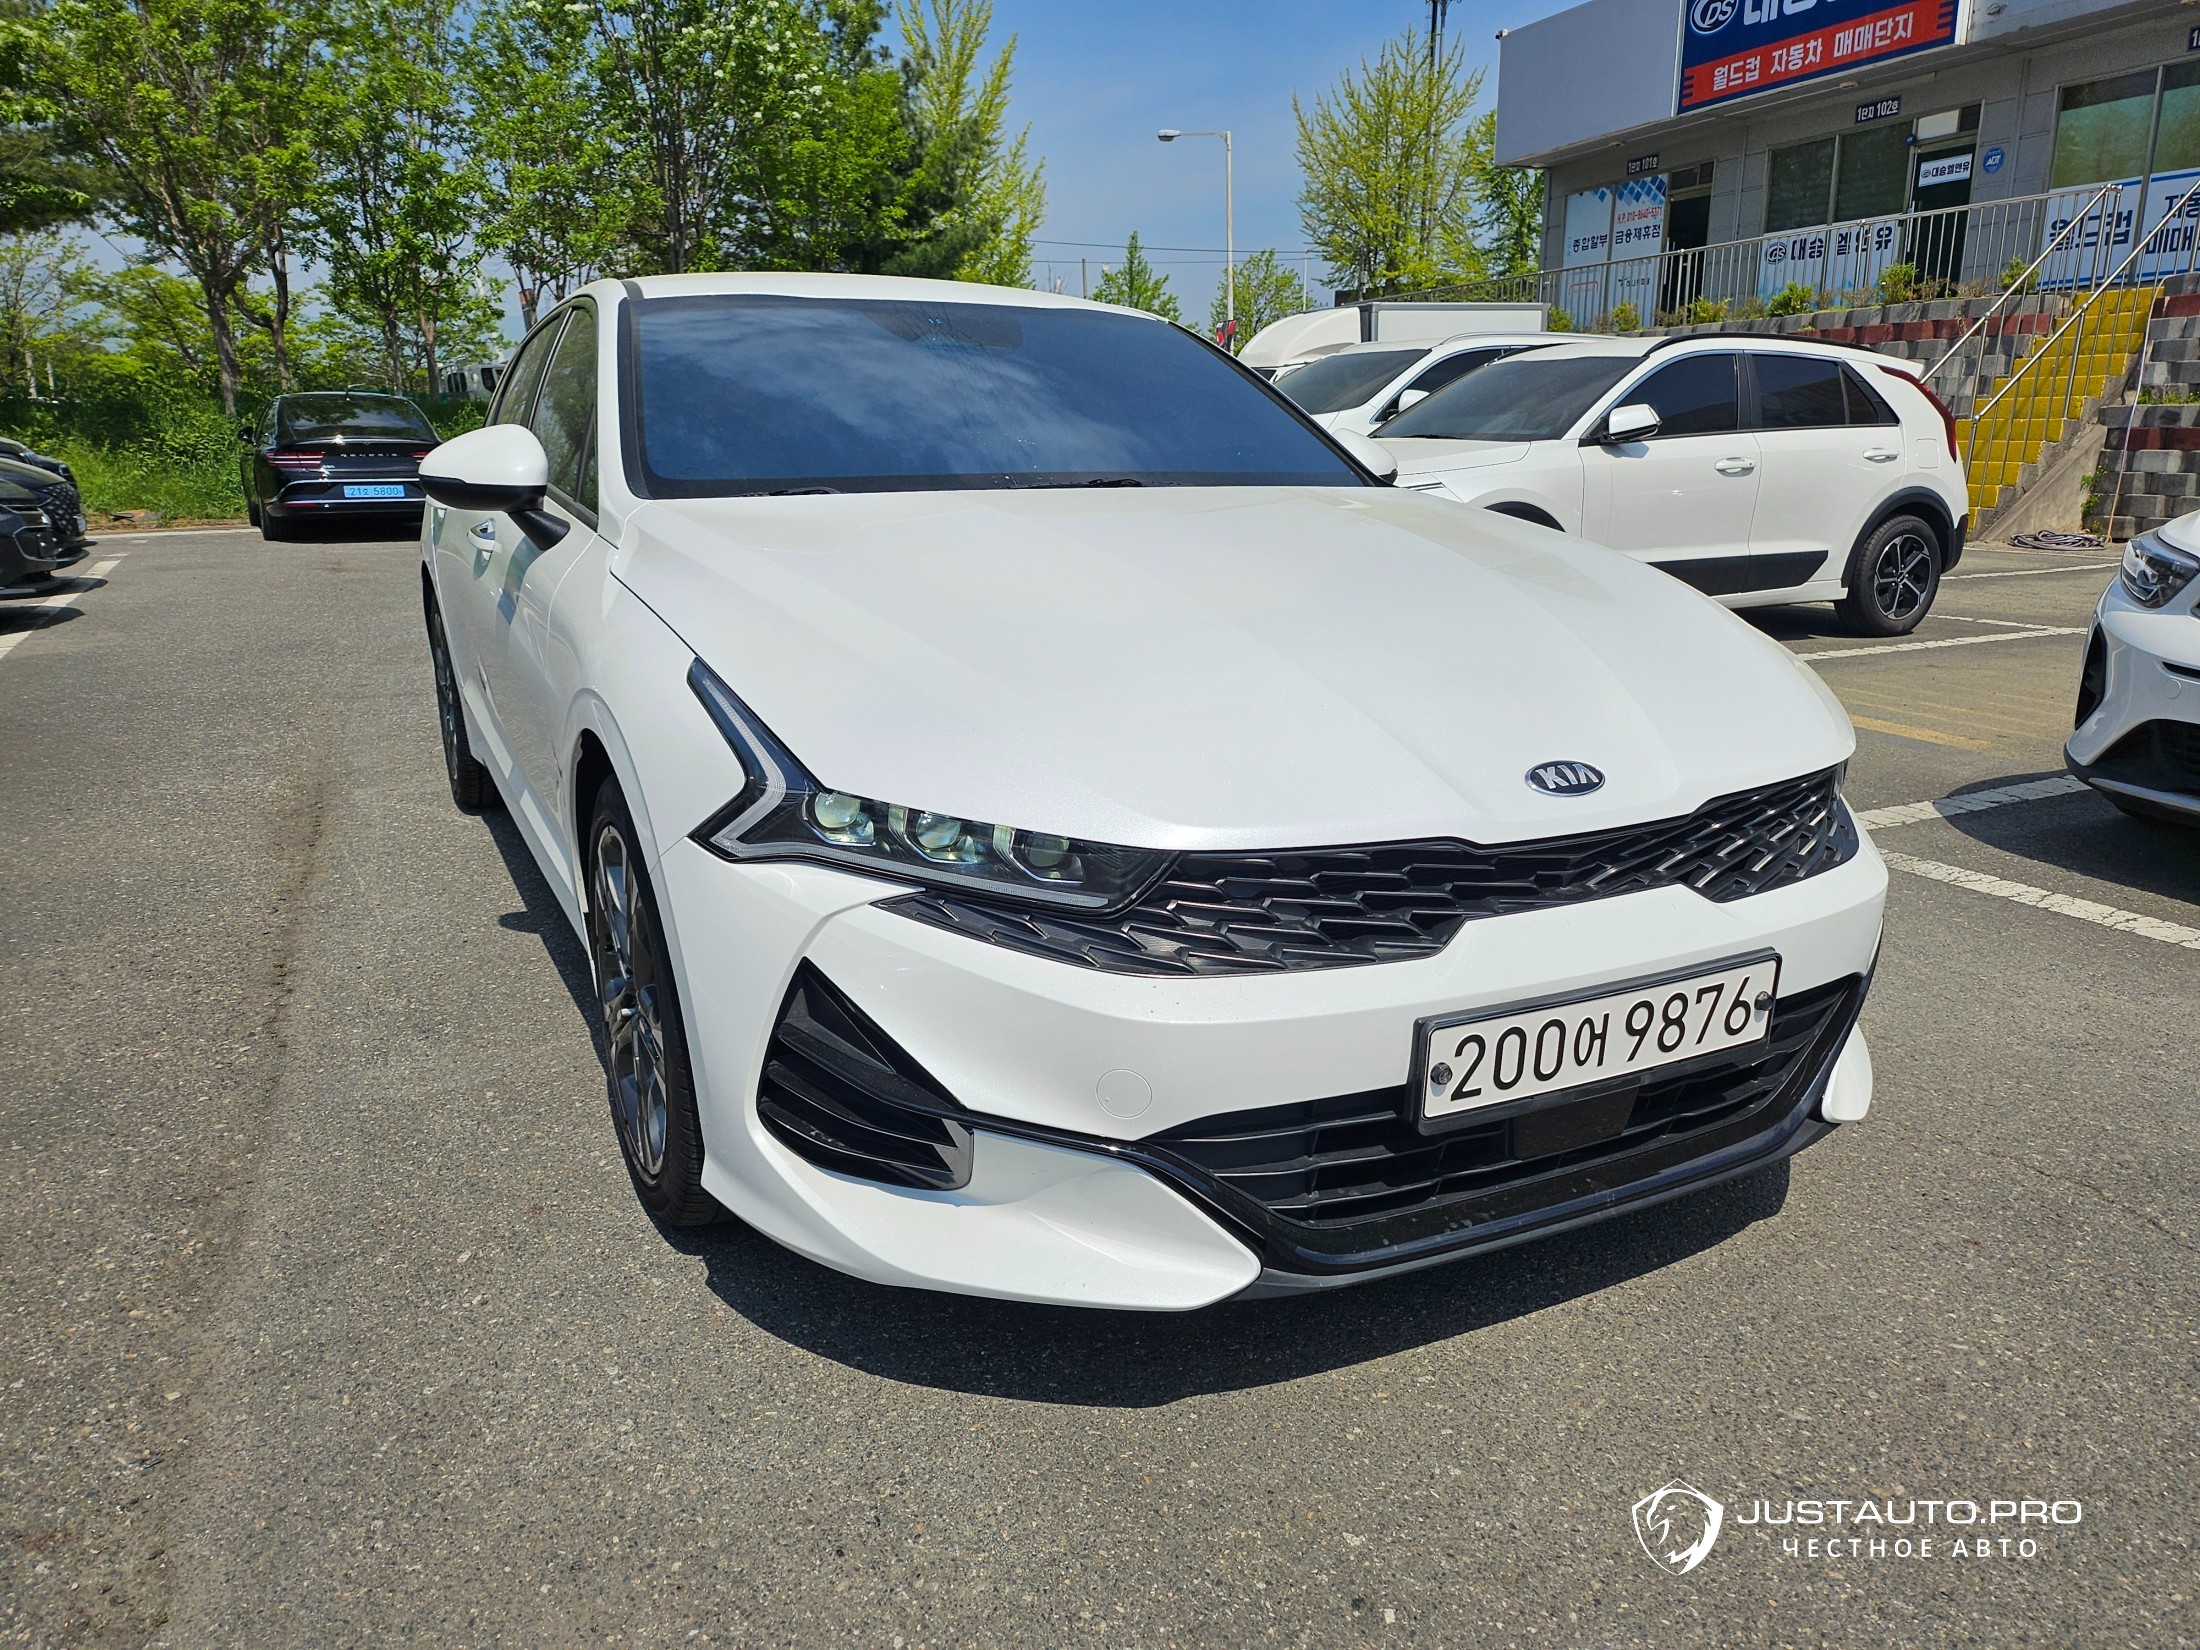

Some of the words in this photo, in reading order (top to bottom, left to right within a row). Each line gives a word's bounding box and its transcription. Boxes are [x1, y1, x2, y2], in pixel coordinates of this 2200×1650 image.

[1713, 56, 1760, 91] 월드컵
[1770, 38, 1822, 74] 자동차
[1833, 12, 1913, 57] 매매단지
[1877, 100, 1898, 117] 102호
[1986, 154, 2002, 166] ADT
[1573, 233, 1607, 253] 종합할부
[1615, 224, 1661, 244] 금융제휴점
[2049, 210, 2133, 251] 월드컵
[1790, 236, 1823, 260] 대승
[1535, 763, 1600, 789] KIA
[1450, 1012, 1610, 1101] 200어
[1624, 976, 1751, 1062] 9876
